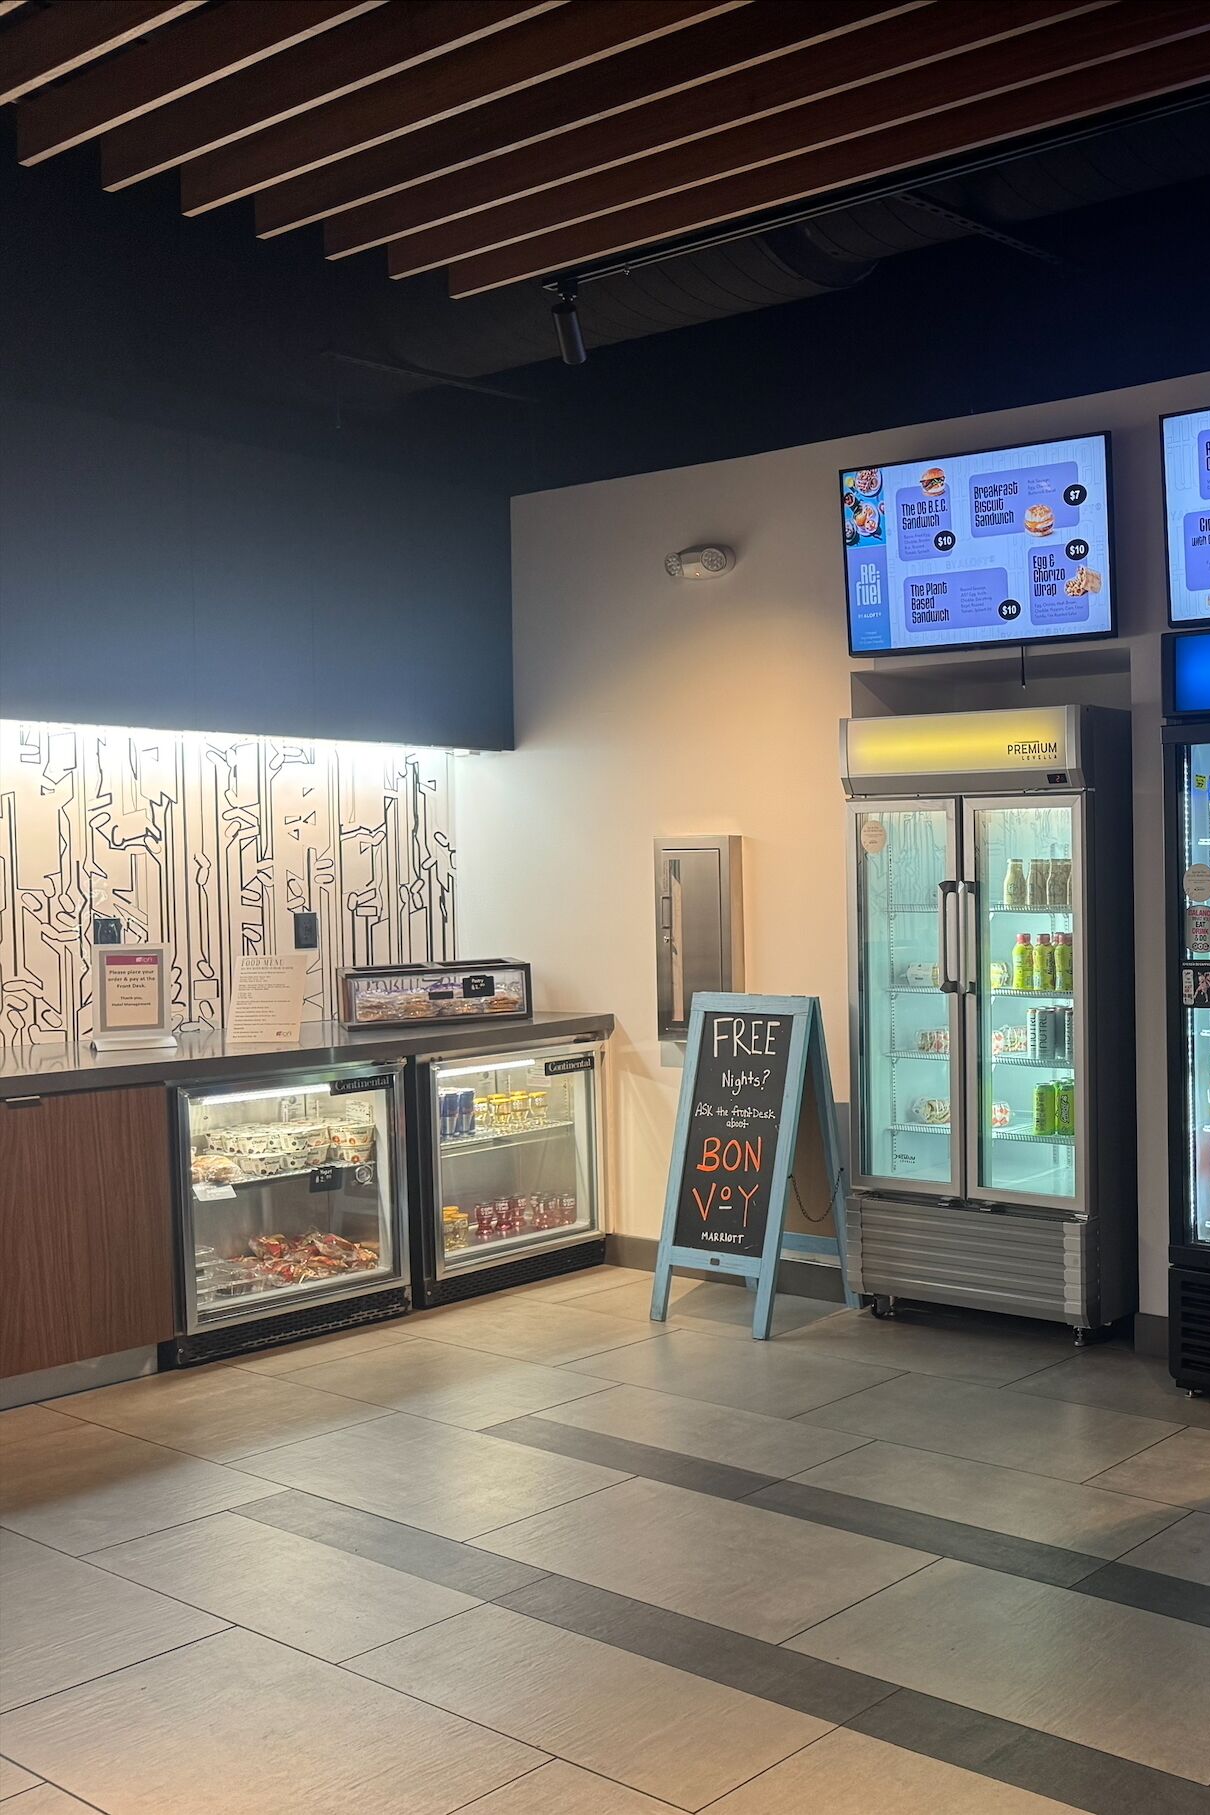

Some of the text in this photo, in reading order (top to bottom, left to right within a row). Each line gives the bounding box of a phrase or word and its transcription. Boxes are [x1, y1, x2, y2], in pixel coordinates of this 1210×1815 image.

[974, 482, 1018, 498] Breakfast
[1070, 490, 1080, 500] $7
[902, 499, 948, 516] The OG B.E.C.
[975, 498, 1004, 512] Biscuit
[902, 514, 940, 530] Sandwich
[975, 510, 1014, 527] Sandwich
[938, 536, 952, 546] $10
[1192, 535, 1207, 546] with
[1070, 544, 1084, 555] $10
[1033, 553, 1054, 569] Egg &
[1034, 567, 1065, 582] Chorizo
[857, 581, 881, 606] fuel
[911, 581, 947, 597] The Plant
[1034, 583, 1057, 597] Wrap
[912, 597, 935, 610] Based
[1002, 605, 1017, 615] $10
[912, 607, 949, 624] Sandwich
[1008, 742, 1057, 754] PREMIUM
[713, 1017, 781, 1058] FREE
[548, 1059, 591, 1072] Continental
[335, 1076, 390, 1091] Continental
[722, 1069, 771, 1096] Nights?
[716, 1106, 728, 1116] the
[697, 1136, 762, 1173] BON
[701, 1230, 744, 1244] MARRIOTT
